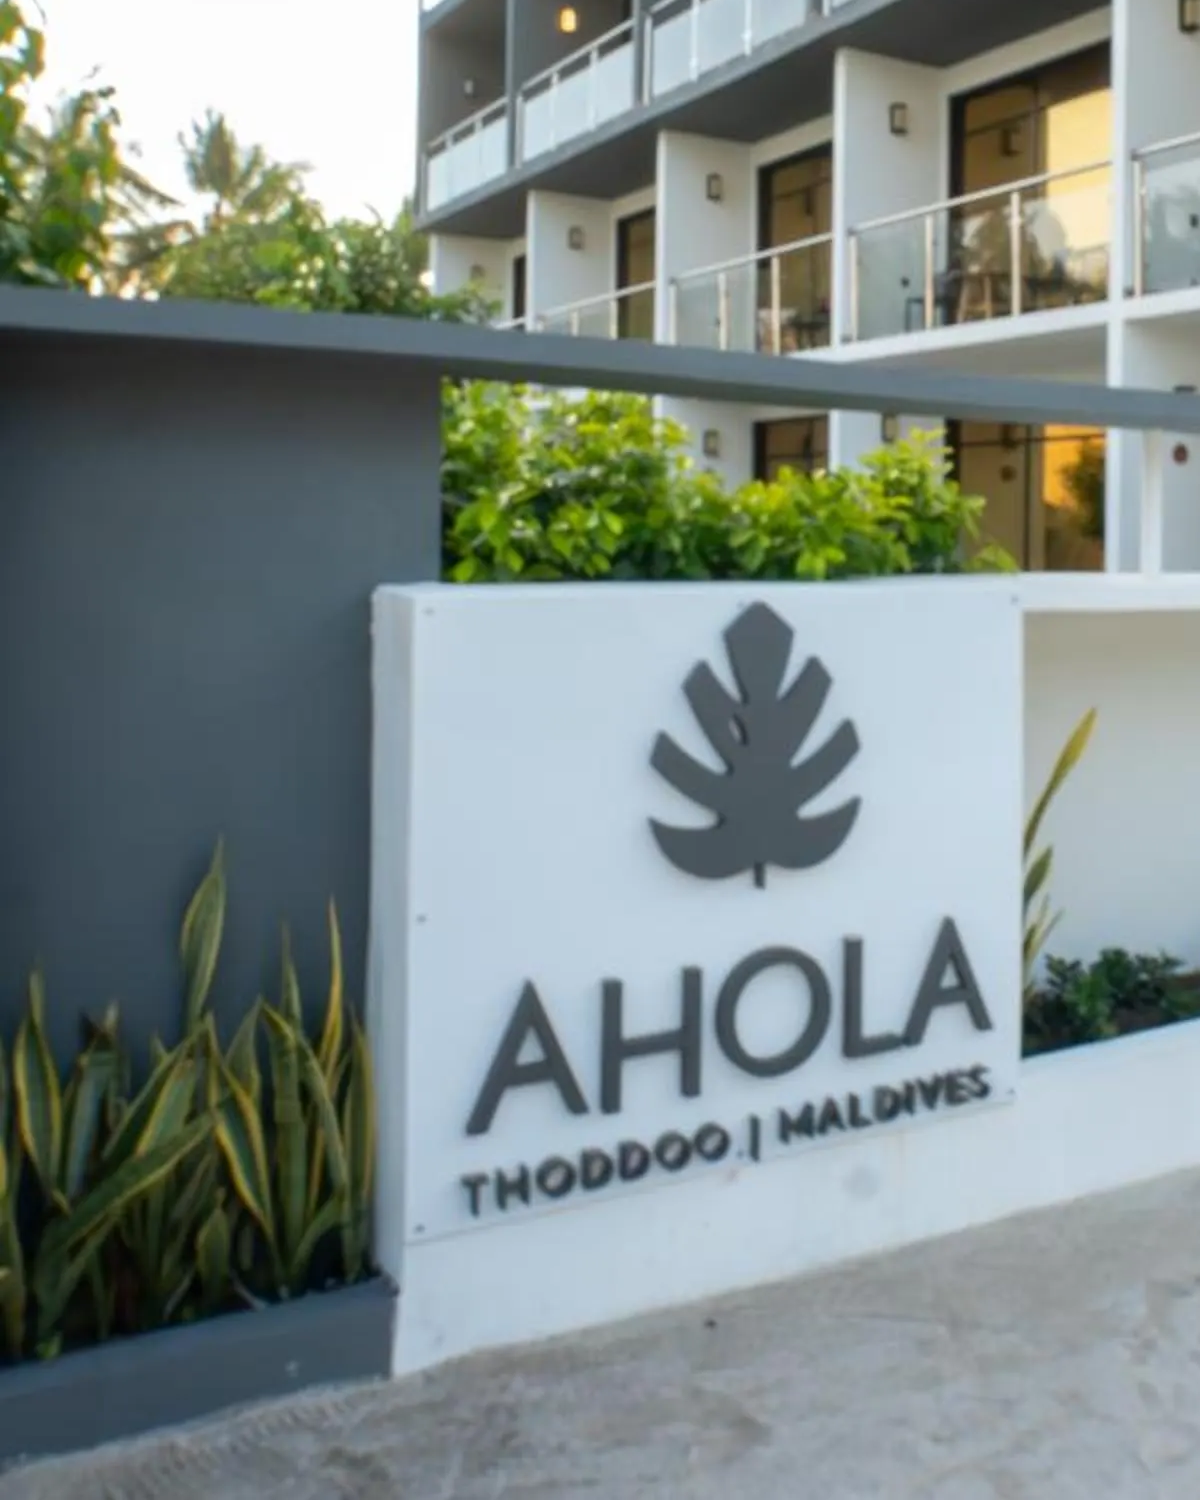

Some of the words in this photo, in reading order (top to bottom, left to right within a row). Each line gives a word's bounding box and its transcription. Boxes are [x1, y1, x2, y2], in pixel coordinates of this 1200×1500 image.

[464, 916, 994, 1138] AHOLA
[461, 1121, 731, 1218] THODDOO
[778, 1064, 992, 1145] MALDIVES
